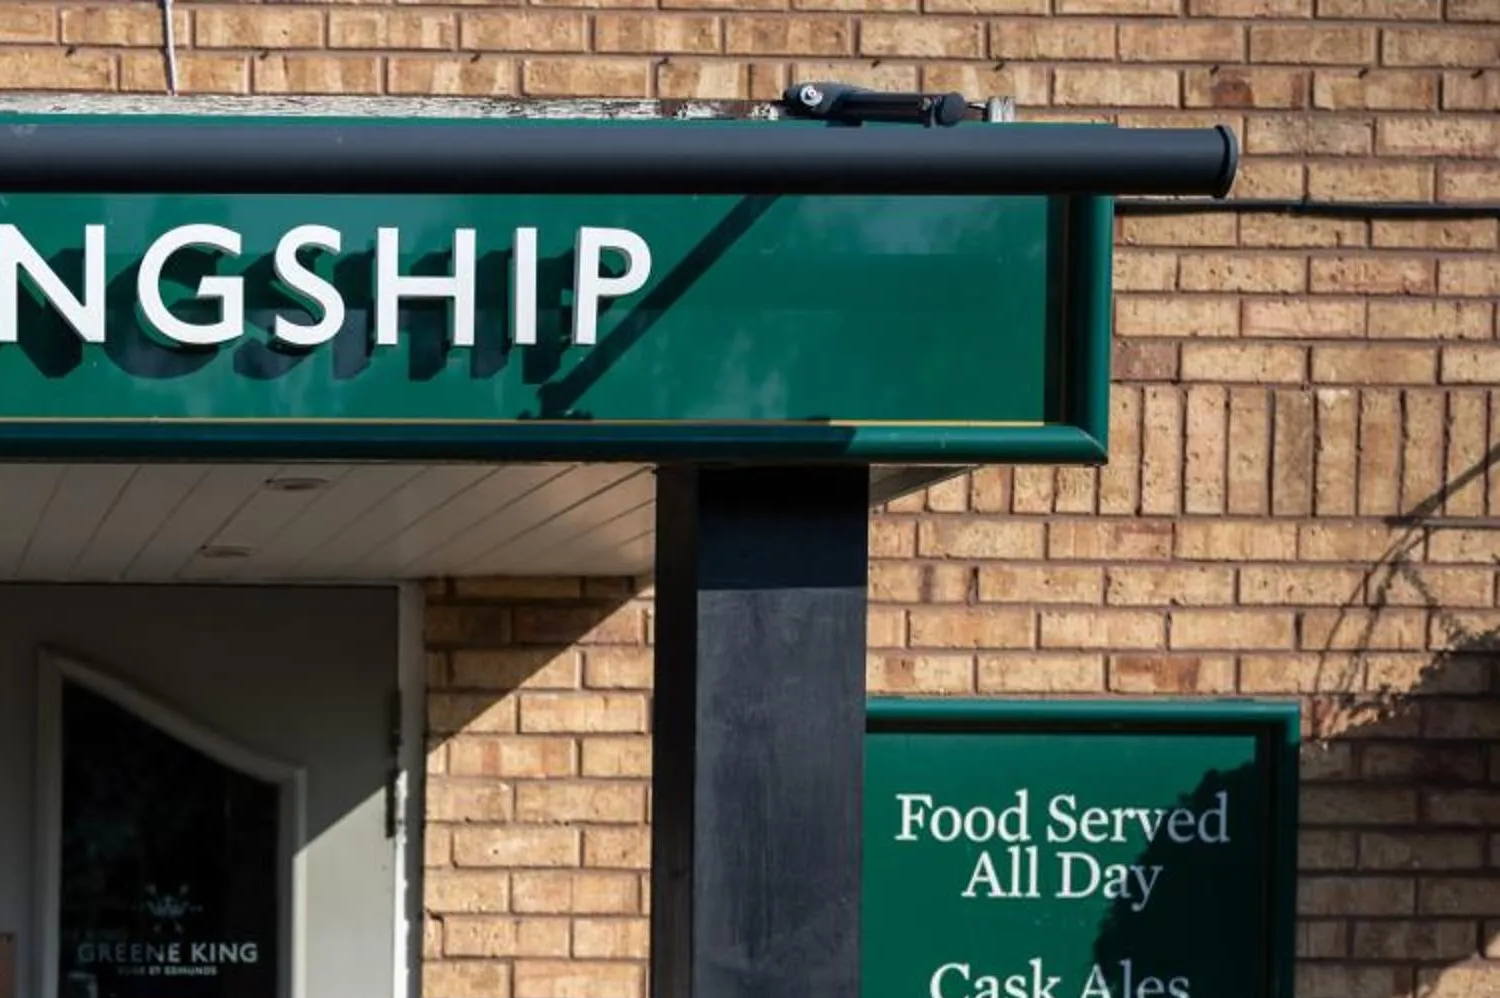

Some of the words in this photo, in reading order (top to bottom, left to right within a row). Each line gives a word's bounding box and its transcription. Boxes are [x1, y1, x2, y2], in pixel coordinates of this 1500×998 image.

[895, 788, 1032, 844] Food
[1046, 790, 1231, 844] Served
[962, 845, 1041, 899] All
[1055, 850, 1164, 912] Day
[76, 942, 182, 965] GREENE
[190, 942, 259, 965] KING
